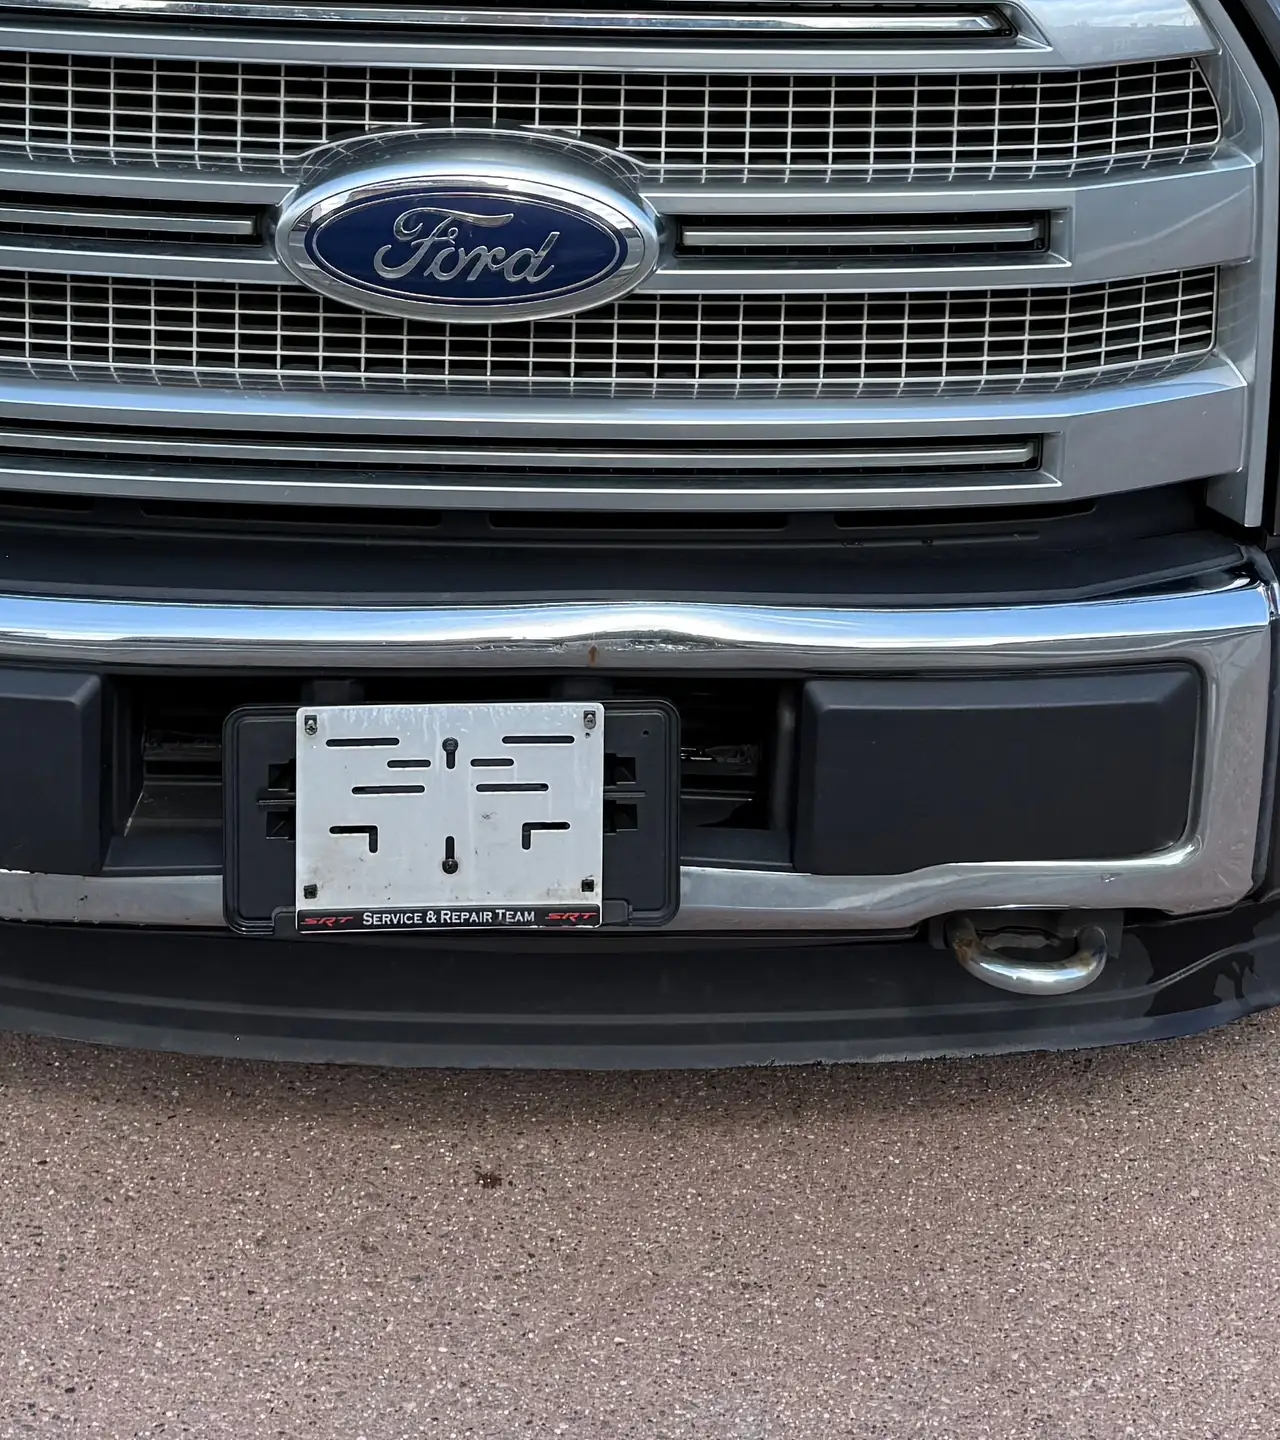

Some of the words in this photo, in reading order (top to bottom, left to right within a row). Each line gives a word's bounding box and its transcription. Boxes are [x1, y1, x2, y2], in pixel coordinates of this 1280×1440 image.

[373, 206, 561, 283] Ford
[301, 916, 354, 927] SRT
[426, 911, 437, 924] &
[545, 912, 597, 923] SRT
